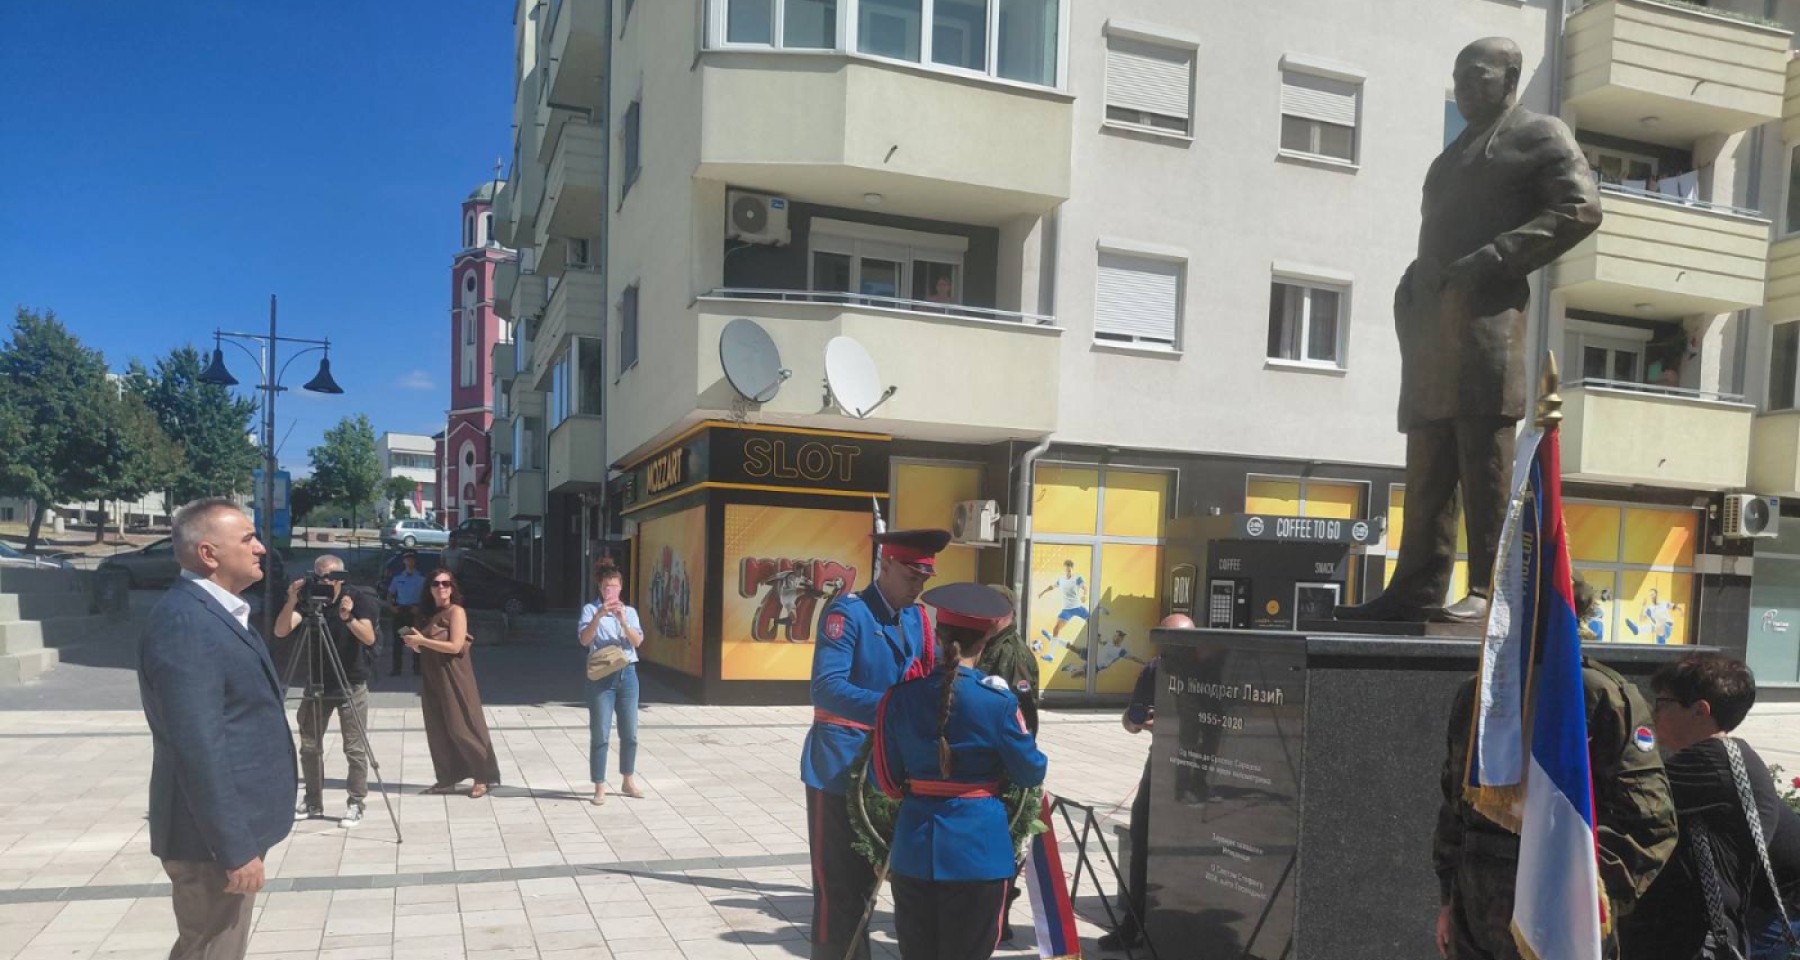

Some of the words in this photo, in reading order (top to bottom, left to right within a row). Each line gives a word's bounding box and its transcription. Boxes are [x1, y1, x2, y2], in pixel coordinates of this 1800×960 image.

[647, 447, 683, 495] MOZZART
[742, 438, 861, 482] SLOT
[1276, 517, 1312, 539] COFFEE
[1313, 519, 1325, 539] TO
[1327, 520, 1341, 540] GO
[1218, 558, 1242, 572] COFFEE
[1315, 562, 1336, 575] SNACK
[1173, 575, 1190, 604] BOX
[1168, 675, 1185, 695] Др
[1242, 683, 1284, 706] Лазић
